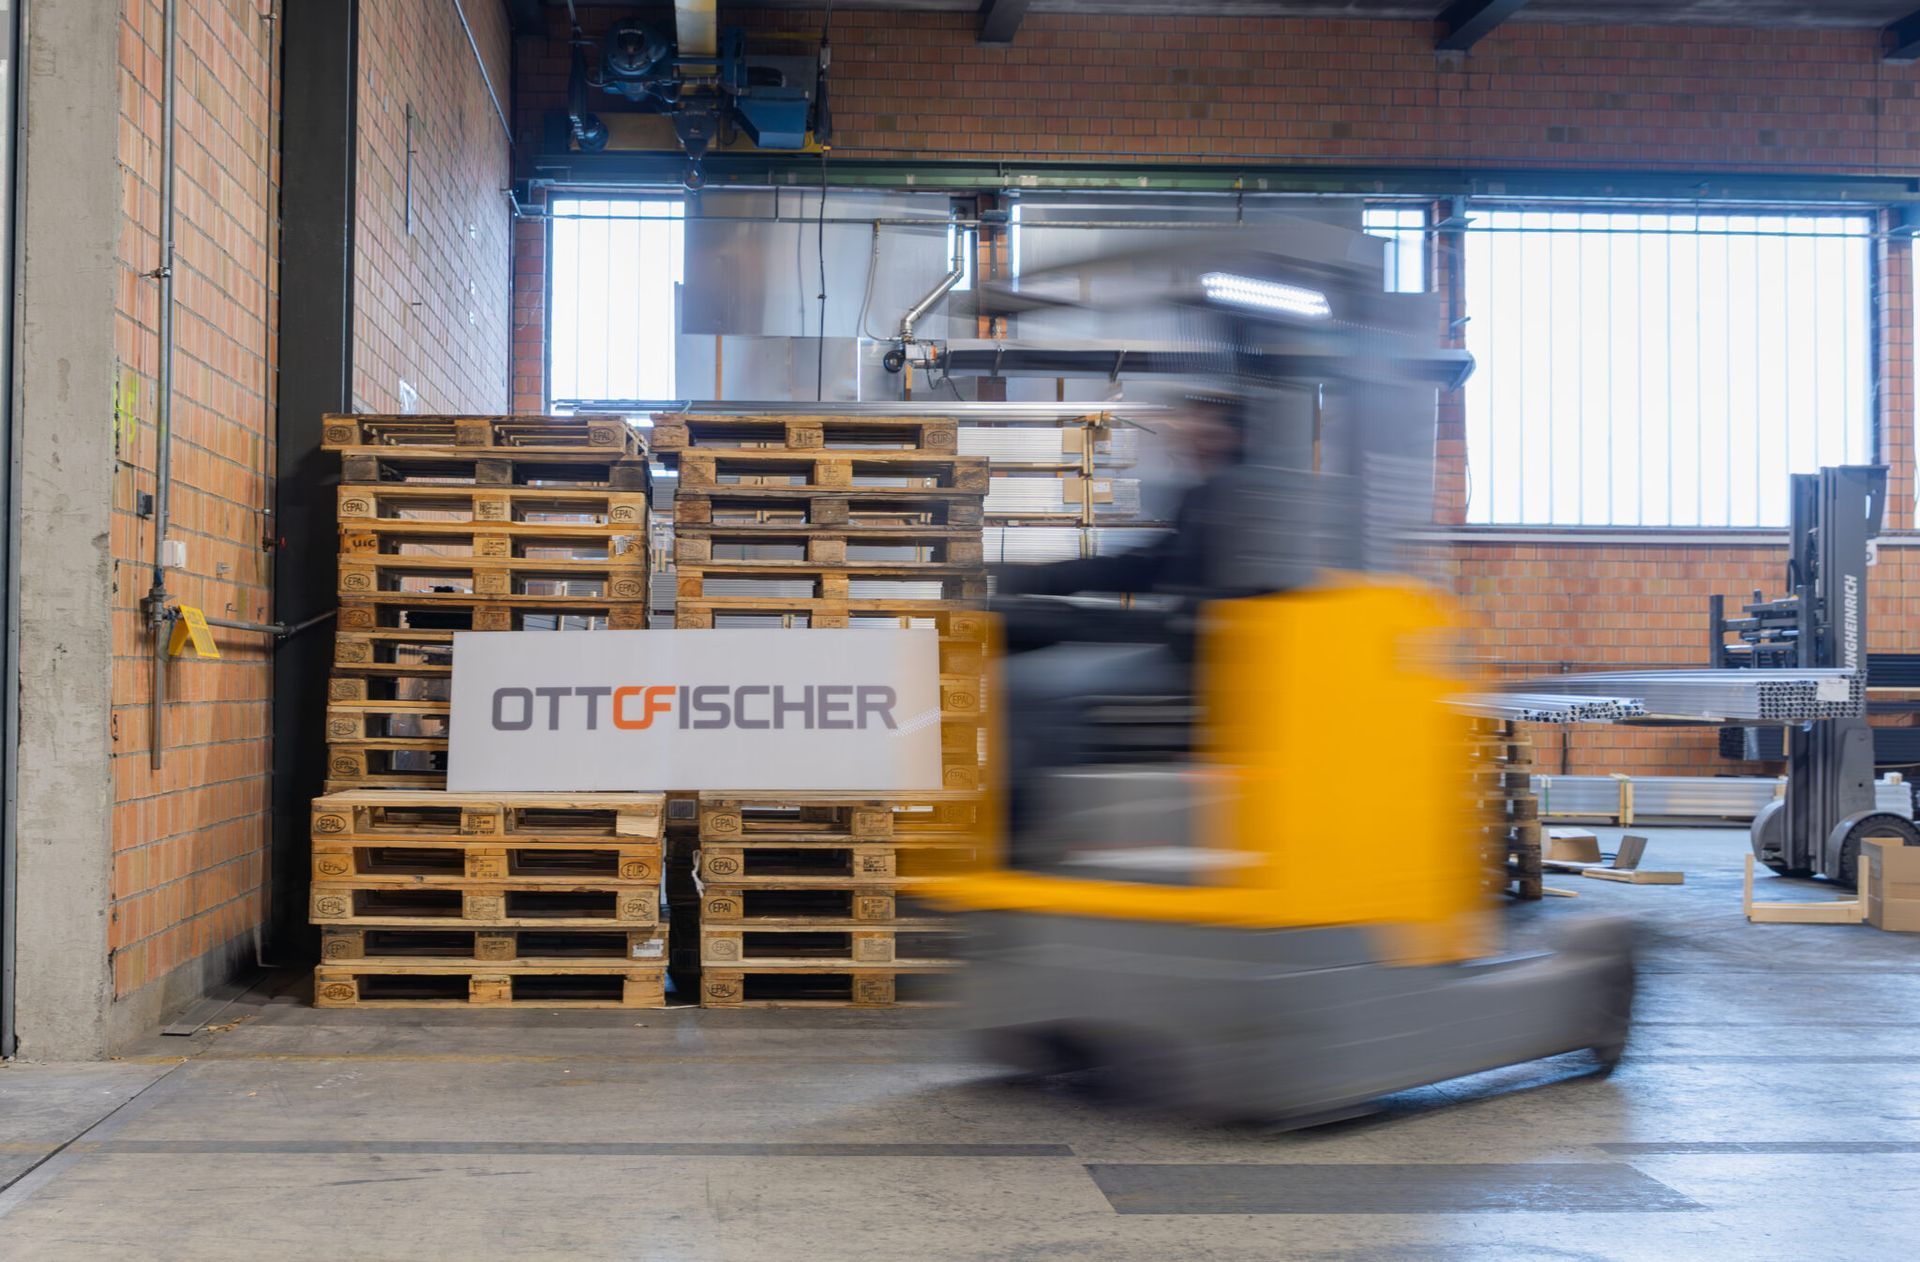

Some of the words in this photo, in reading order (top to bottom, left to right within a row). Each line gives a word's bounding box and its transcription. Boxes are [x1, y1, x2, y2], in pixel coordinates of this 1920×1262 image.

[1844, 574, 1858, 670] UNGHEINRICH
[319, 818, 342, 830] EPAL
[715, 817, 737, 828] EPAL
[713, 860, 734, 871] EPAL
[321, 901, 342, 912] EPAL
[627, 902, 646, 914] EPAL
